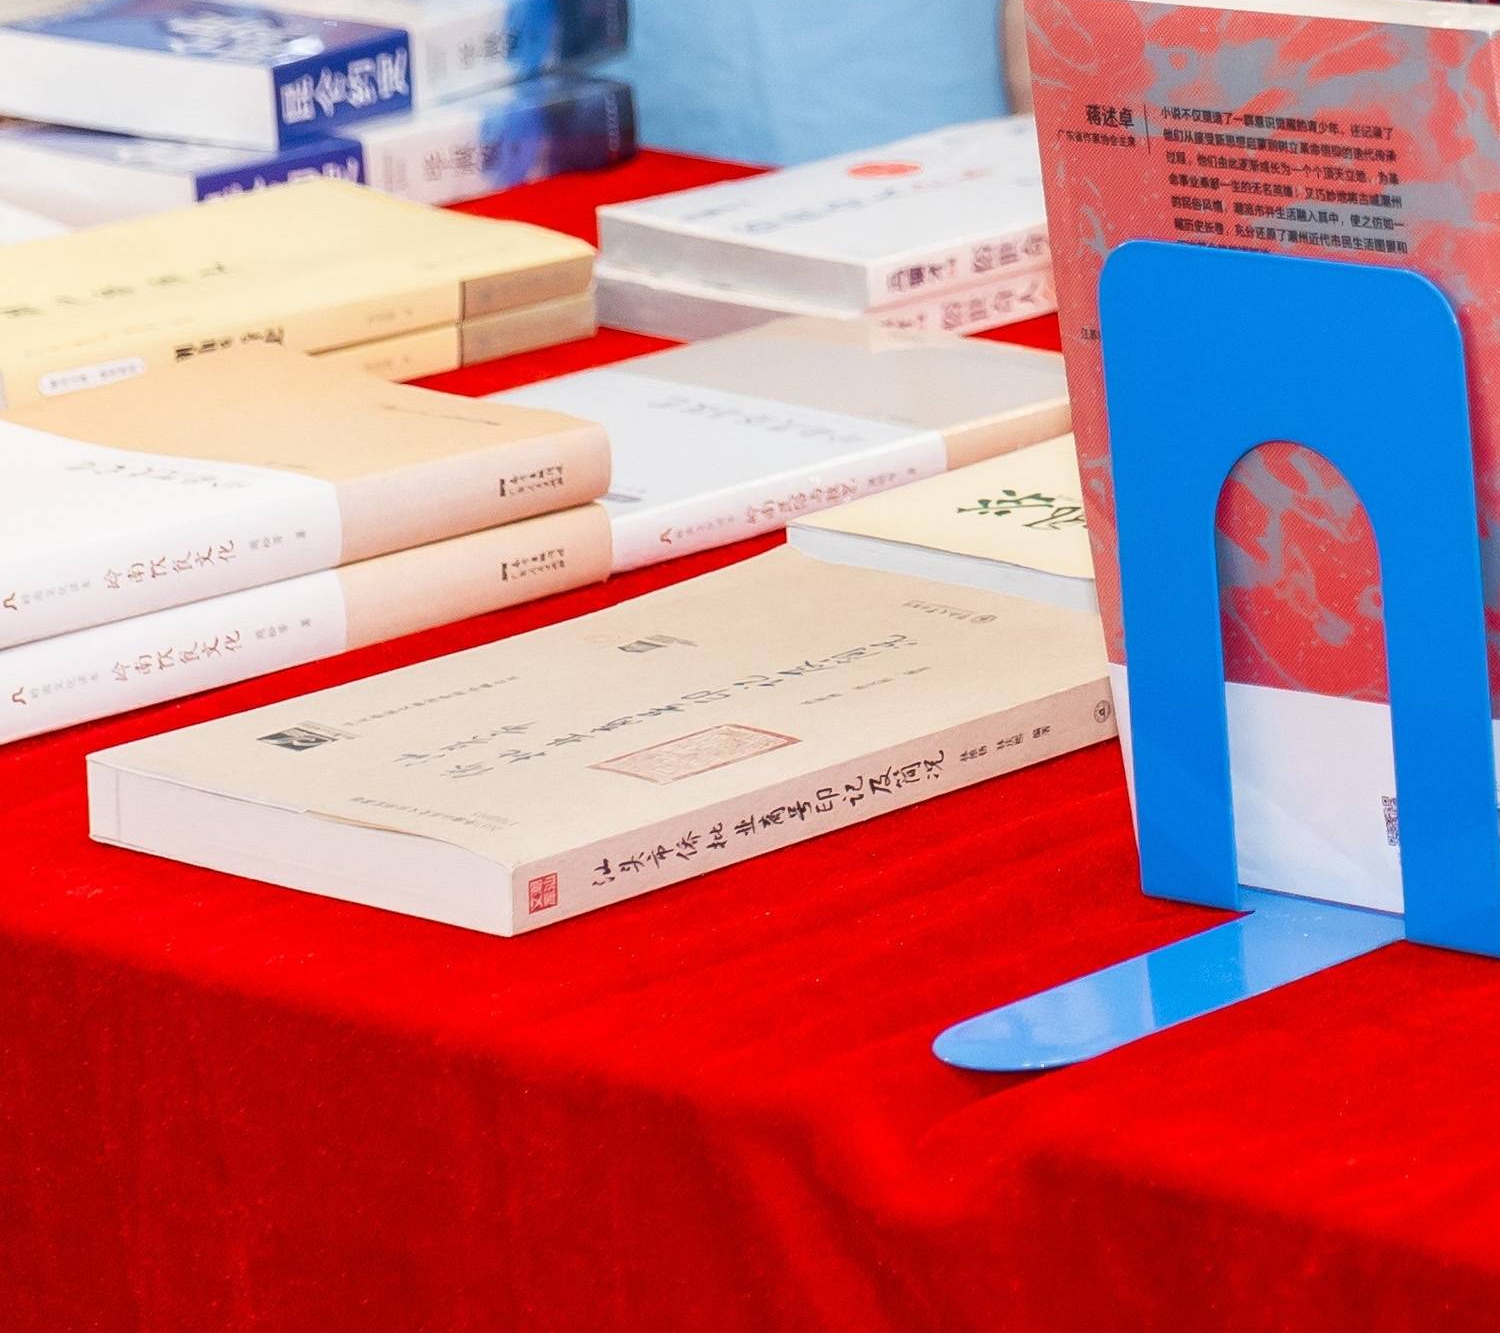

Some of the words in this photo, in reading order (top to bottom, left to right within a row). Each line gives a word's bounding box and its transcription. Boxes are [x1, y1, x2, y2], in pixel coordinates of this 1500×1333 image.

[1085, 102, 1135, 130] 蒋述卓
[591, 749, 946, 889] 汕头市侨批业商号印记及简况
